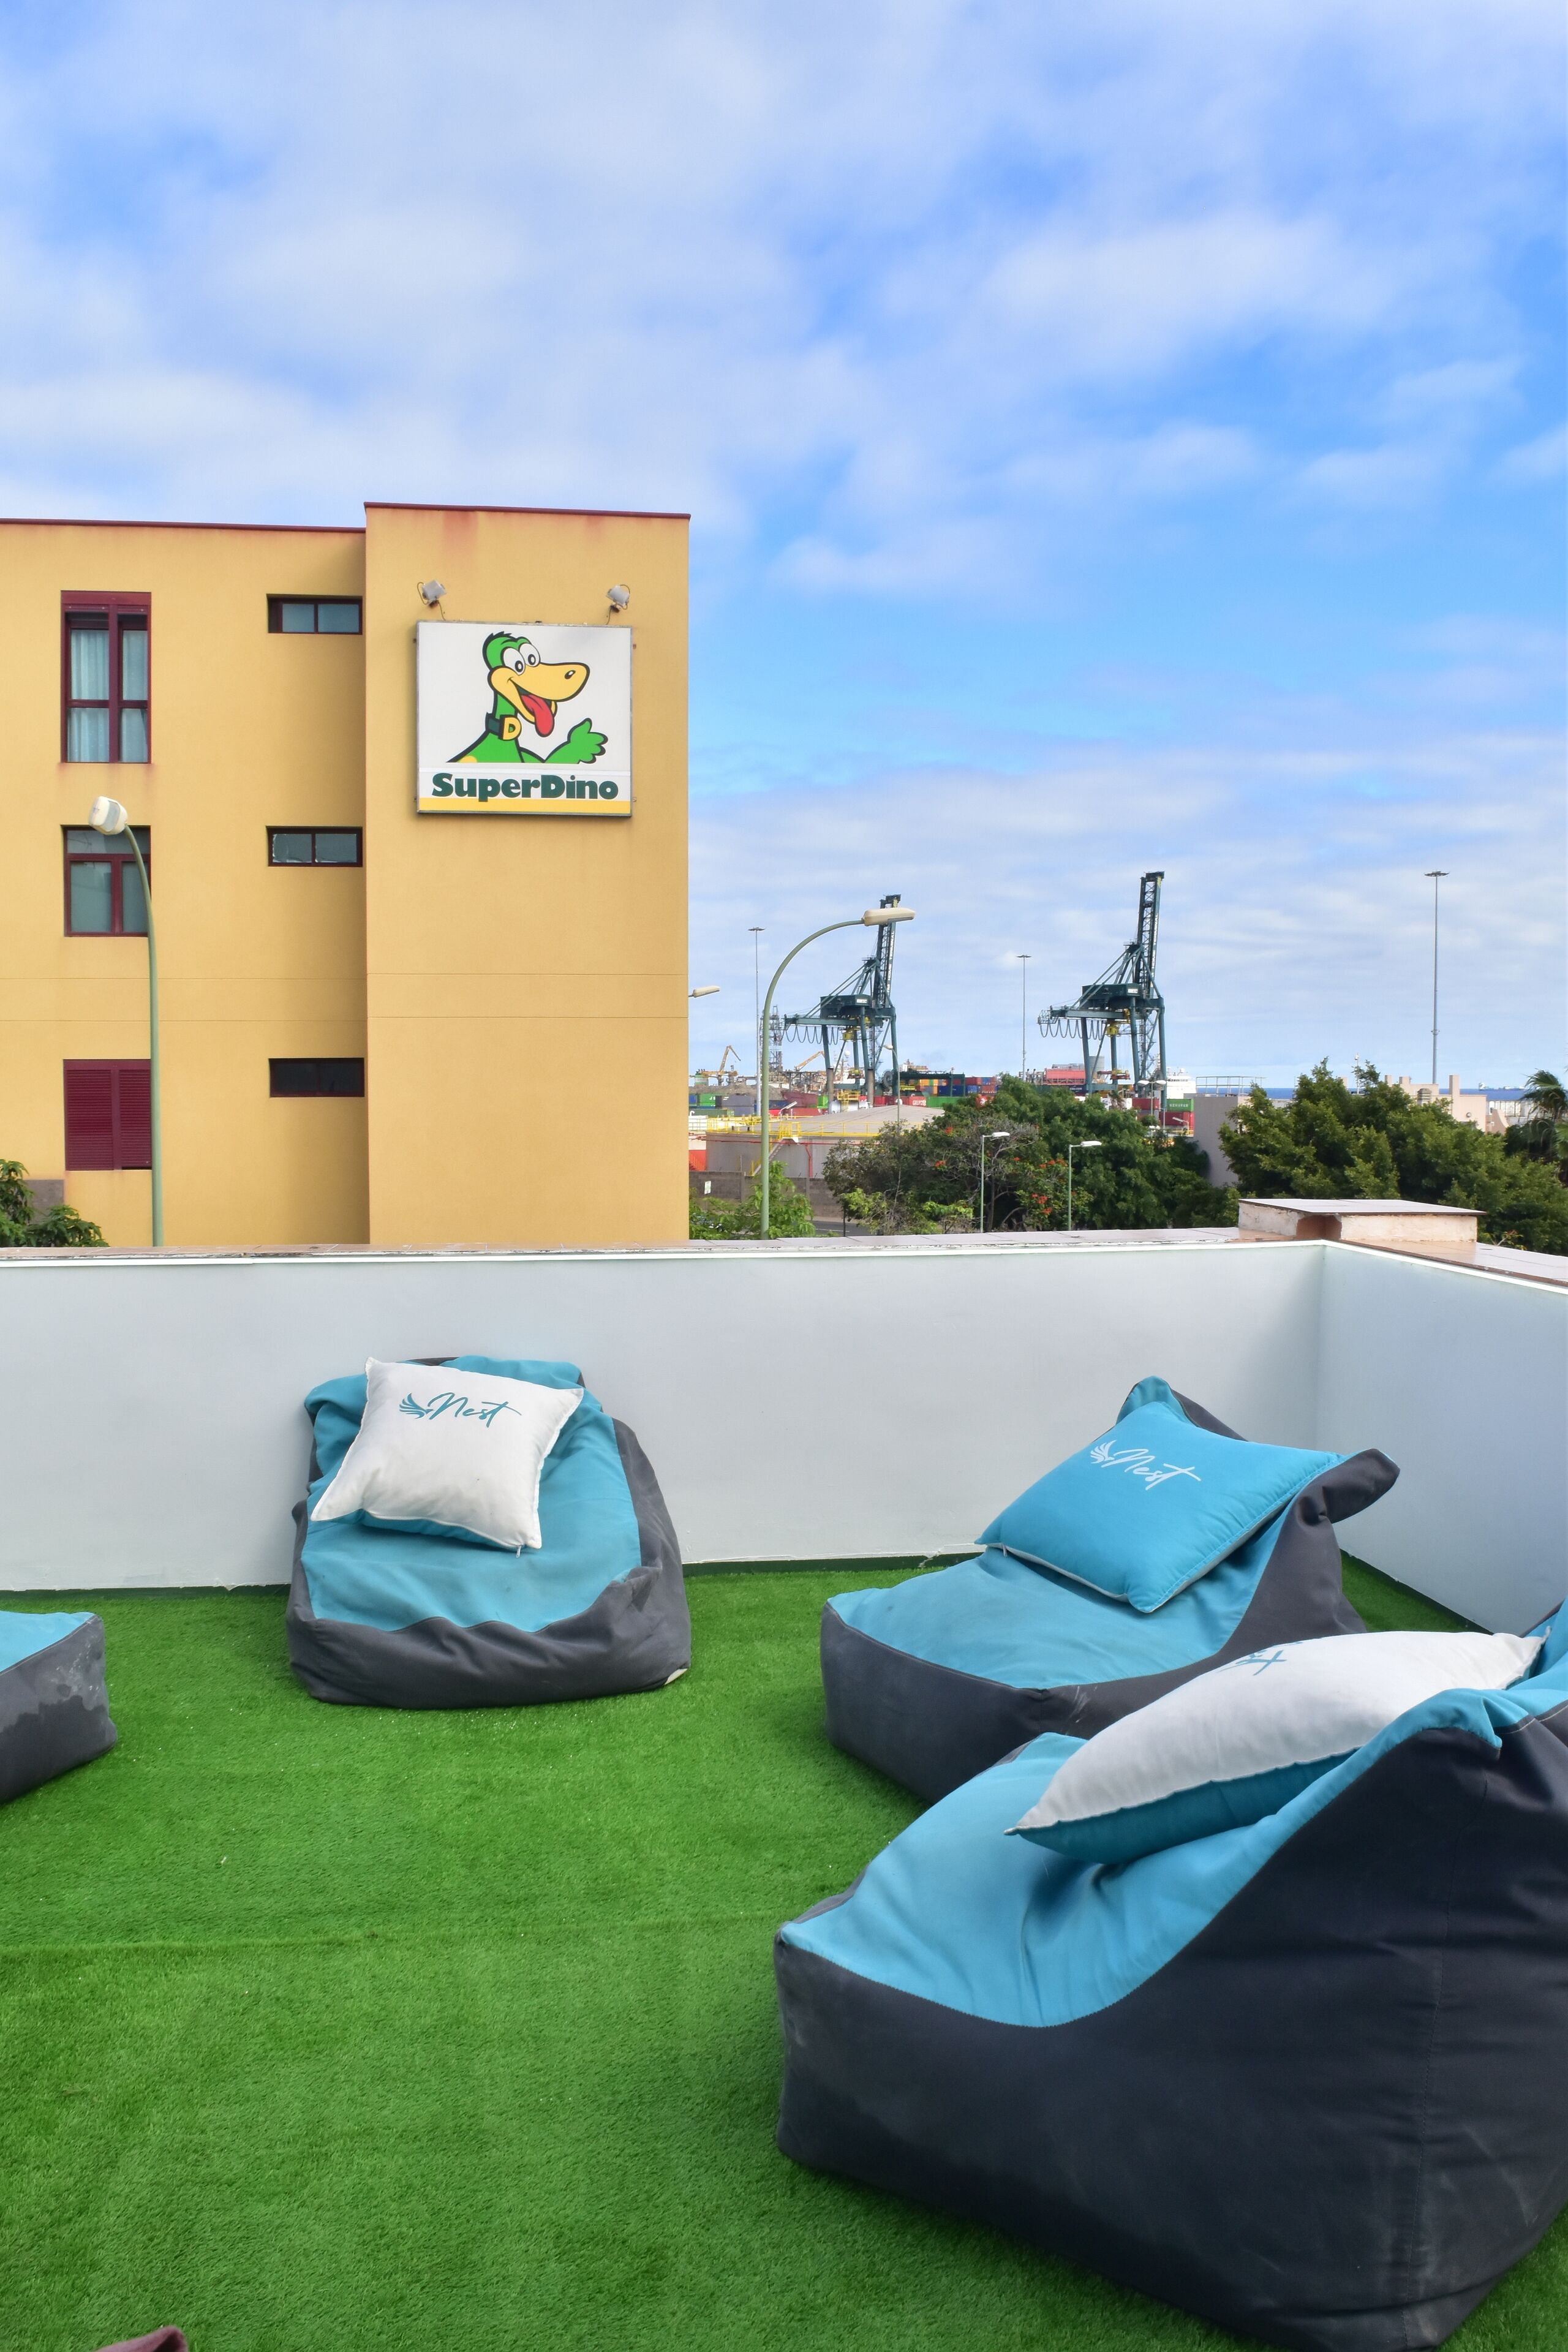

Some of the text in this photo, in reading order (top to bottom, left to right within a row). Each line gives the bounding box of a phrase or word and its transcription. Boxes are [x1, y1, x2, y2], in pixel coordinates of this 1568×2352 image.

[432, 772, 619, 802] SuperDino
[428, 1392, 522, 1428] Nest
[1101, 1447, 1202, 1491] Nest
